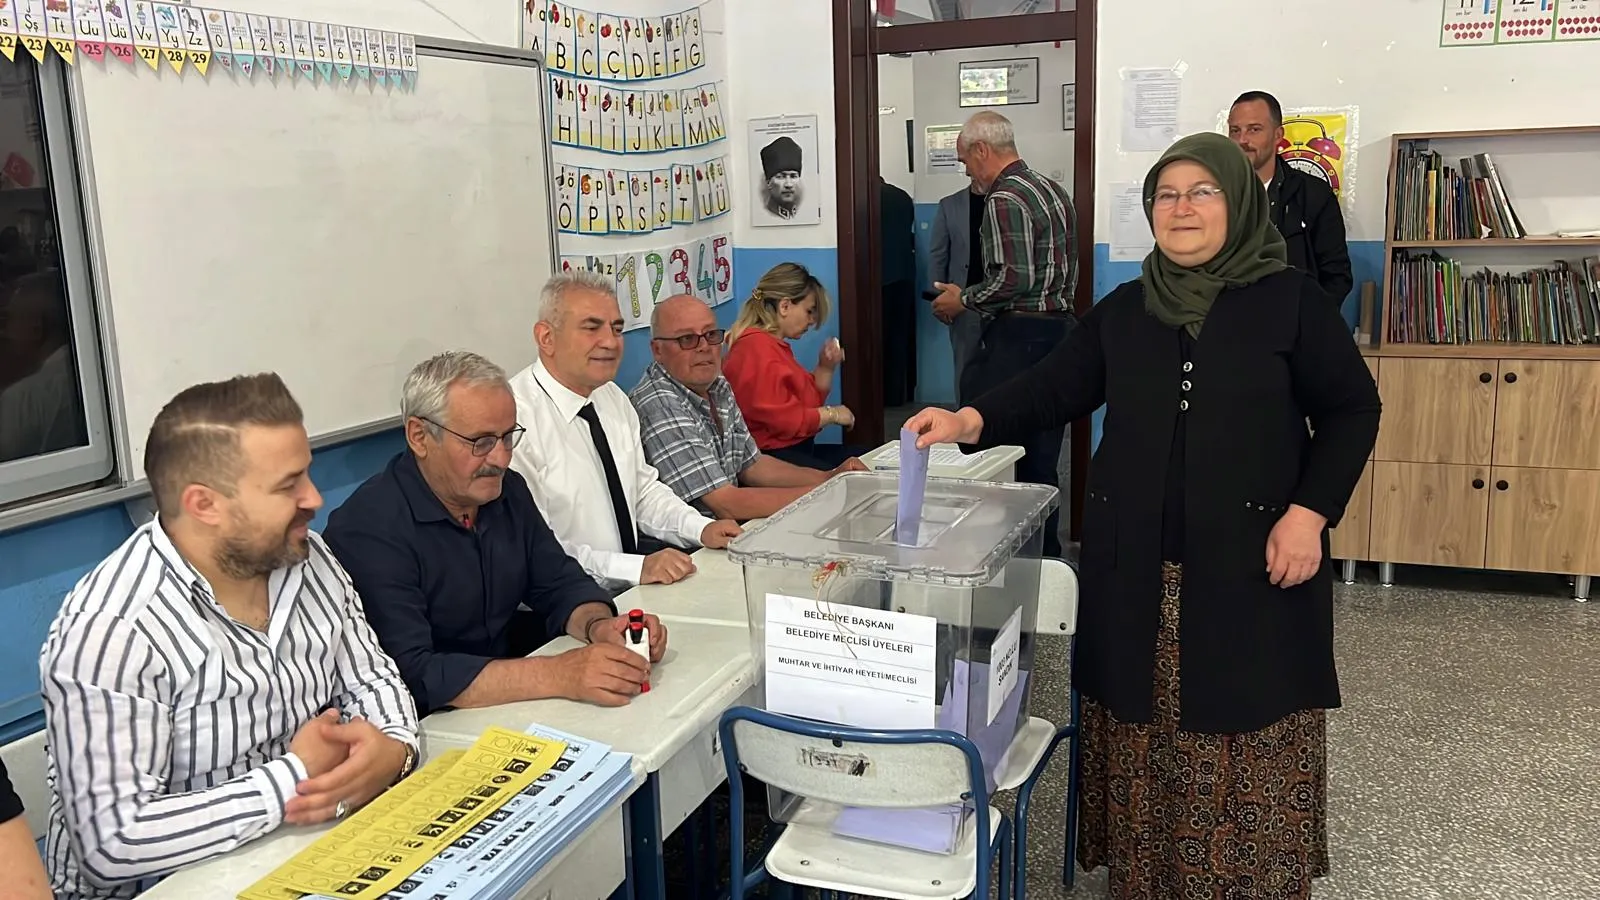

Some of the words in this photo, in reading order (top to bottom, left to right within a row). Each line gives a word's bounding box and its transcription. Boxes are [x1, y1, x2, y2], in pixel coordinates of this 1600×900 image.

[24, 14, 38, 32] Şş
[52, 16, 66, 33] Tt
[80, 20, 99, 36] Uu
[108, 18, 127, 39] Üü
[134, 25, 152, 40] Vv
[161, 28, 180, 48] Yy
[186, 30, 203, 46] Zz
[259, 38, 267, 51] 2
[279, 41, 286, 54] 3
[298, 43, 305, 56] 4
[318, 45, 325, 58] 5
[338, 47, 344, 59] 6
[355, 49, 362, 61] 7
[373, 51, 379, 63] 8
[389, 53, 395, 65] 9
[404, 55, 413, 67] 10
[27, 38, 43, 51] 23
[56, 42, 72, 53] 24
[84, 43, 101, 55] 25
[114, 46, 131, 57] 26
[142, 48, 156, 59] 27
[168, 51, 183, 62] 28
[192, 52, 207, 64] 29
[556, 42, 566, 69] B
[582, 49, 593, 75] C
[607, 51, 620, 78] Ç
[633, 53, 644, 78] D
[653, 52, 662, 77] E
[673, 48, 681, 72] F
[689, 43, 700, 66] G
[558, 114, 571, 143] H
[633, 126, 640, 151] J
[653, 125, 663, 150] K
[671, 124, 679, 147] L
[688, 120, 704, 145] M
[708, 115, 721, 138] N
[589, 205, 599, 231] P
[616, 205, 625, 230] R
[638, 206, 646, 230] S
[659, 202, 666, 227] Ş
[679, 197, 688, 220] T
[702, 192, 713, 216] U
[716, 183, 726, 212] Ü
[617, 255, 640, 318] 1
[645, 253, 664, 304] 2
[670, 248, 692, 296] 3
[696, 243, 713, 298] 4
[713, 237, 731, 292] 5
[804, 610, 849, 623] BELEDİYE
[852, 617, 894, 630] BAŞKANI
[786, 627, 830, 640] BELEDİYE
[833, 634, 870, 646] MECLİSİ
[873, 640, 913, 653] ÜYELERİ
[778, 657, 810, 668] MUHTAR
[824, 663, 853, 674] İHTİYAR
